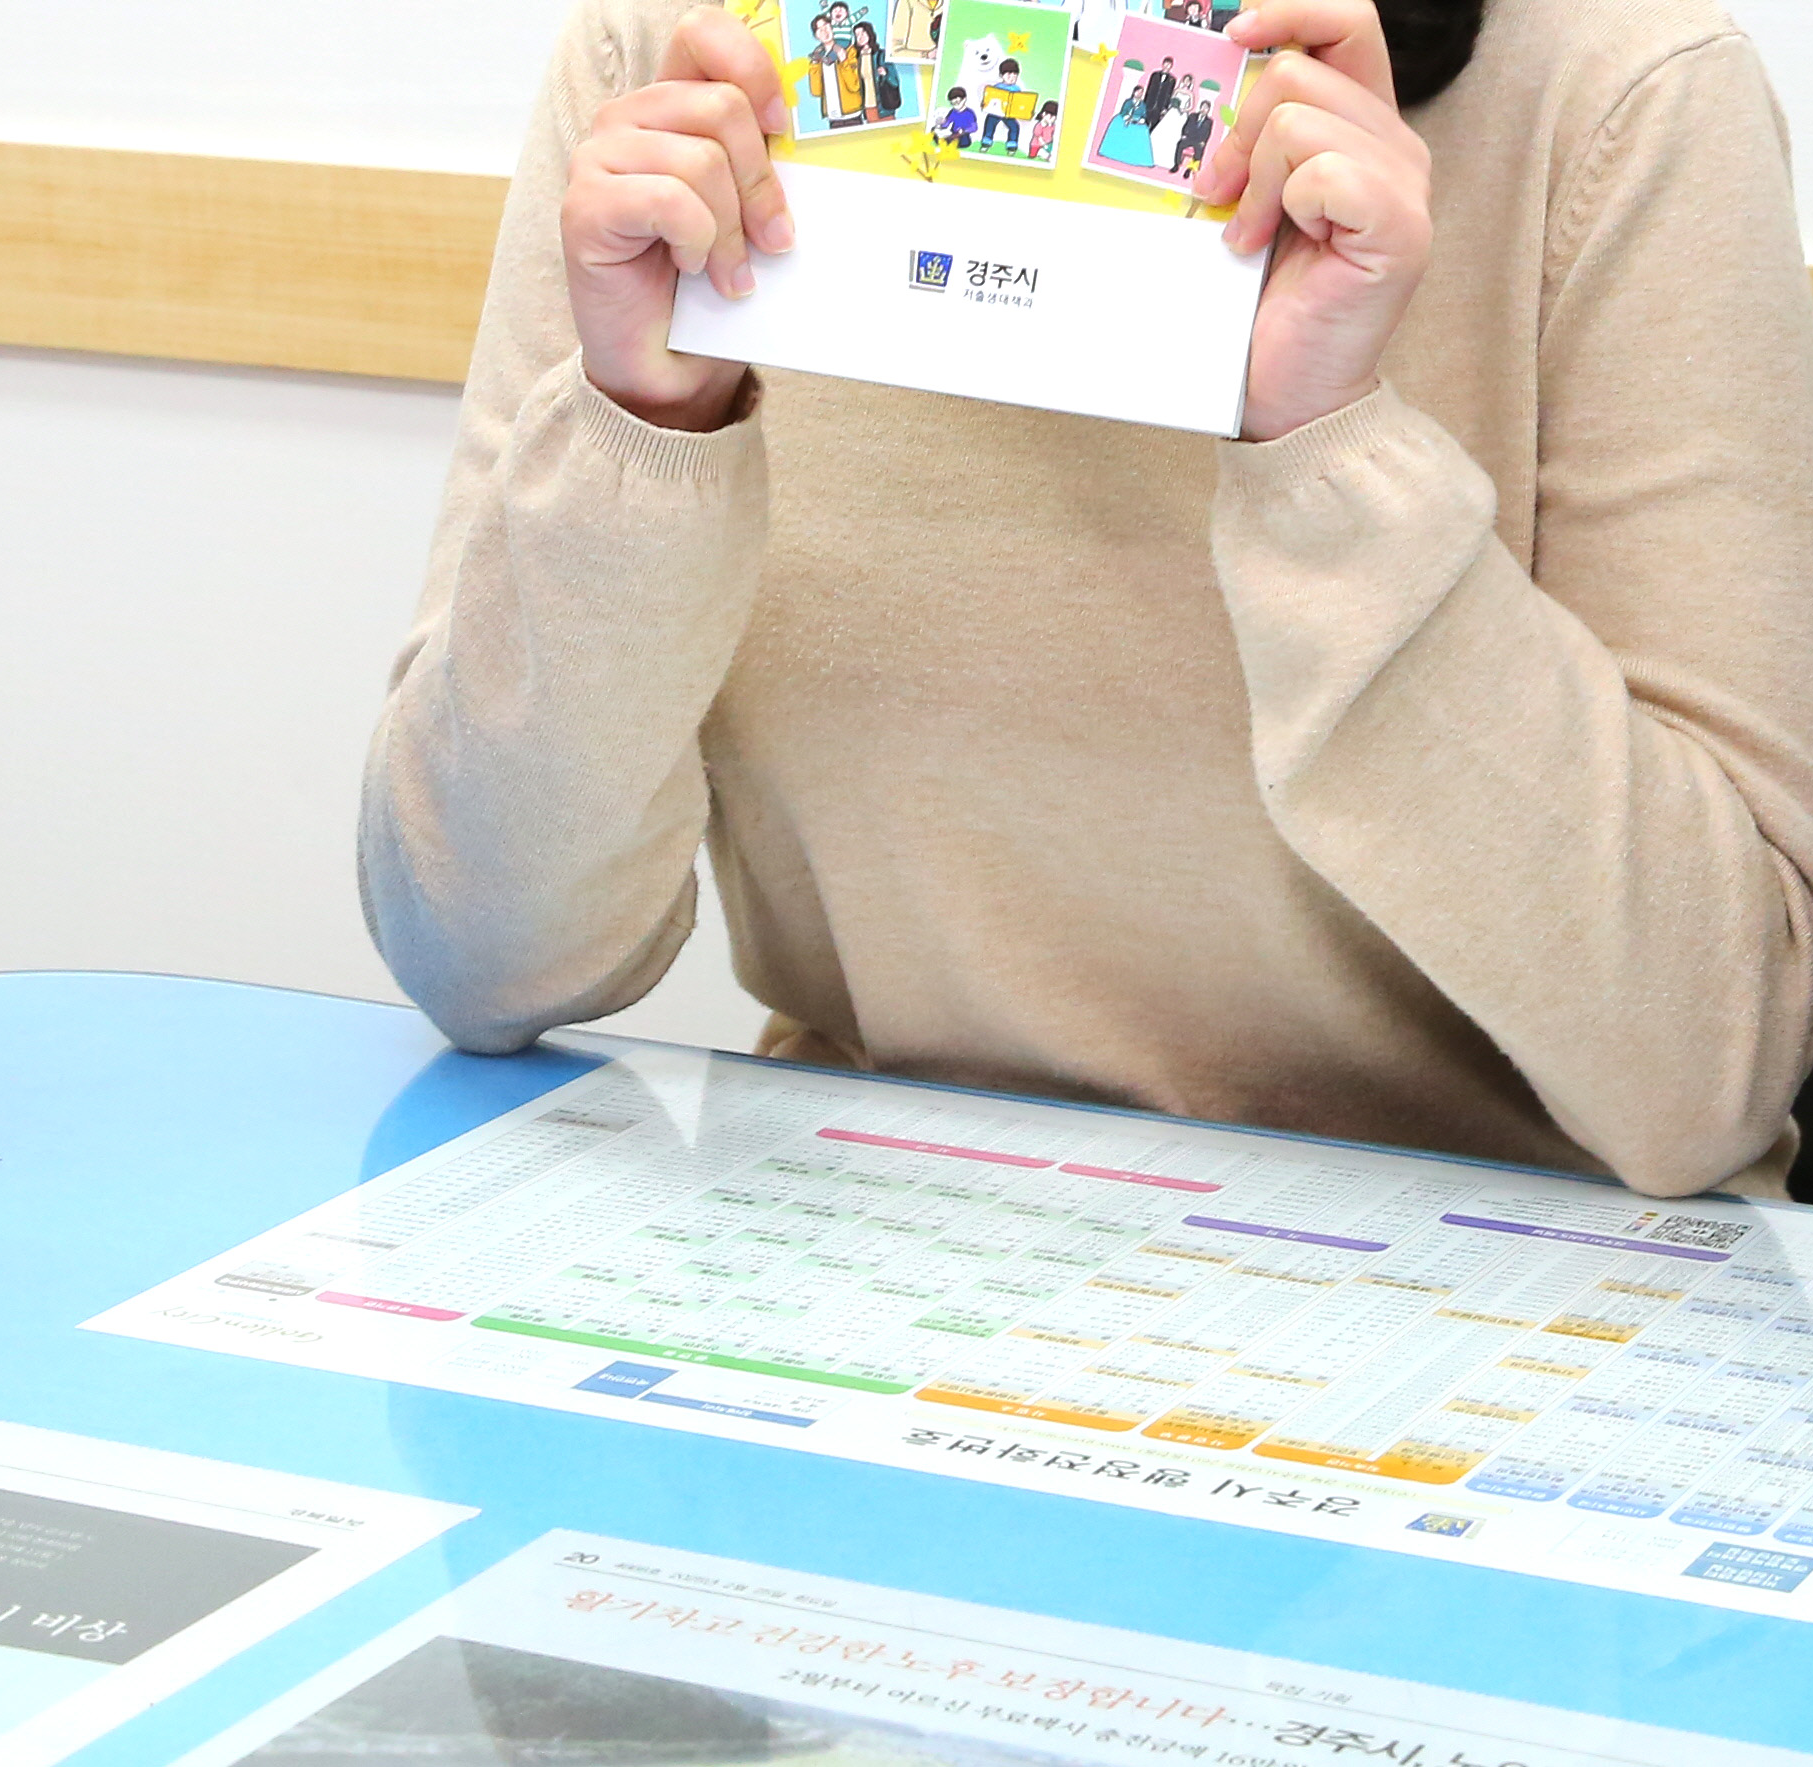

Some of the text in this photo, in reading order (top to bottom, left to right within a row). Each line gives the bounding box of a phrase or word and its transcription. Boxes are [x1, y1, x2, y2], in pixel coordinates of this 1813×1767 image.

[966, 260, 1039, 293] 경주시
[963, 288, 1034, 309] 저출생대책과
[890, 1425, 1370, 1519] 경주시 행정전화번호
[563, 1551, 601, 1565] 20
[30, 1611, 129, 1644] 비상
[563, 1587, 747, 1639] 활기차고
[754, 1625, 887, 1664] 건강한
[883, 1649, 990, 1682] 노후
